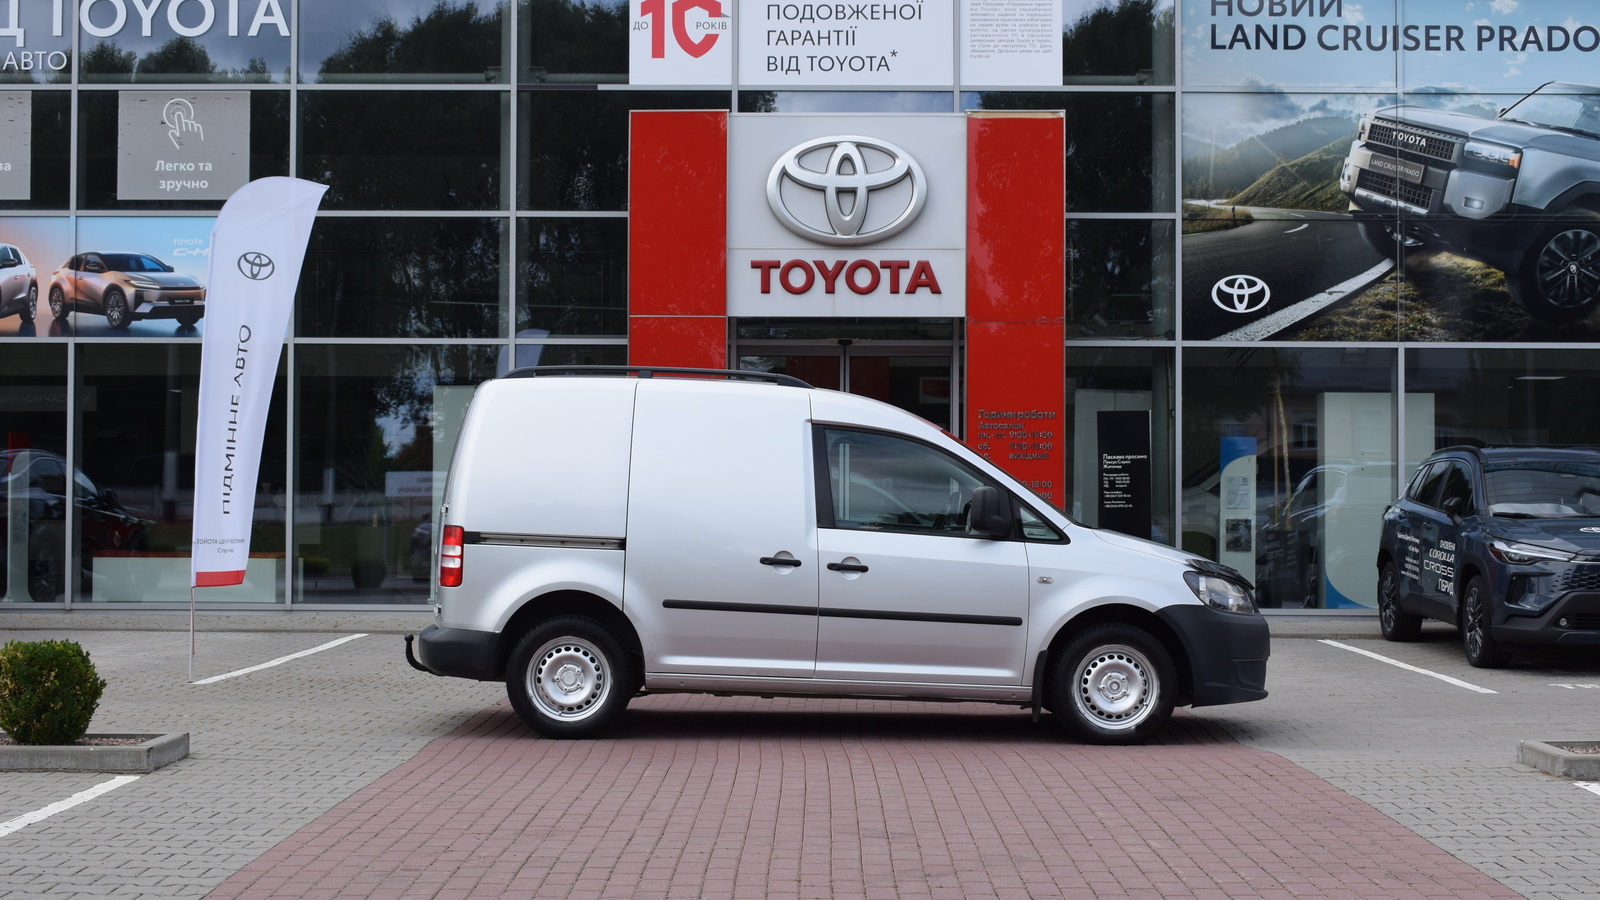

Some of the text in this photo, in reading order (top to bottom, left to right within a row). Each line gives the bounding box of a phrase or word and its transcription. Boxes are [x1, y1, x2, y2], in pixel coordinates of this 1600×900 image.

[766, 1, 923, 23] ПОДОВЖЕНОЇ
[633, 22, 649, 31] ДО
[696, 21, 727, 30] РОКІВ
[766, 26, 856, 46] ГАРАНТІЇ
[1210, 24, 1600, 52] LAND CRUISER PRADO
[2, 51, 67, 70] АВТО
[766, 55, 800, 75] ВІД
[1392, 131, 1426, 147] TOYOTA
[155, 160, 213, 172] Легко та
[159, 178, 209, 190] зручно
[172, 238, 204, 246] TOYOTA
[172, 247, 210, 256] C-H
[751, 259, 942, 295] TOYOTA
[223, 324, 252, 515] ПІДМІННЕ АВТО
[978, 409, 1056, 420] Години роботи
[978, 422, 1025, 430] Автосалон
[978, 442, 991, 450] сб.
[1009, 452, 1049, 460] вихідний
[1429, 548, 1455, 563] COROLLA
[1424, 560, 1454, 578] CROSS
